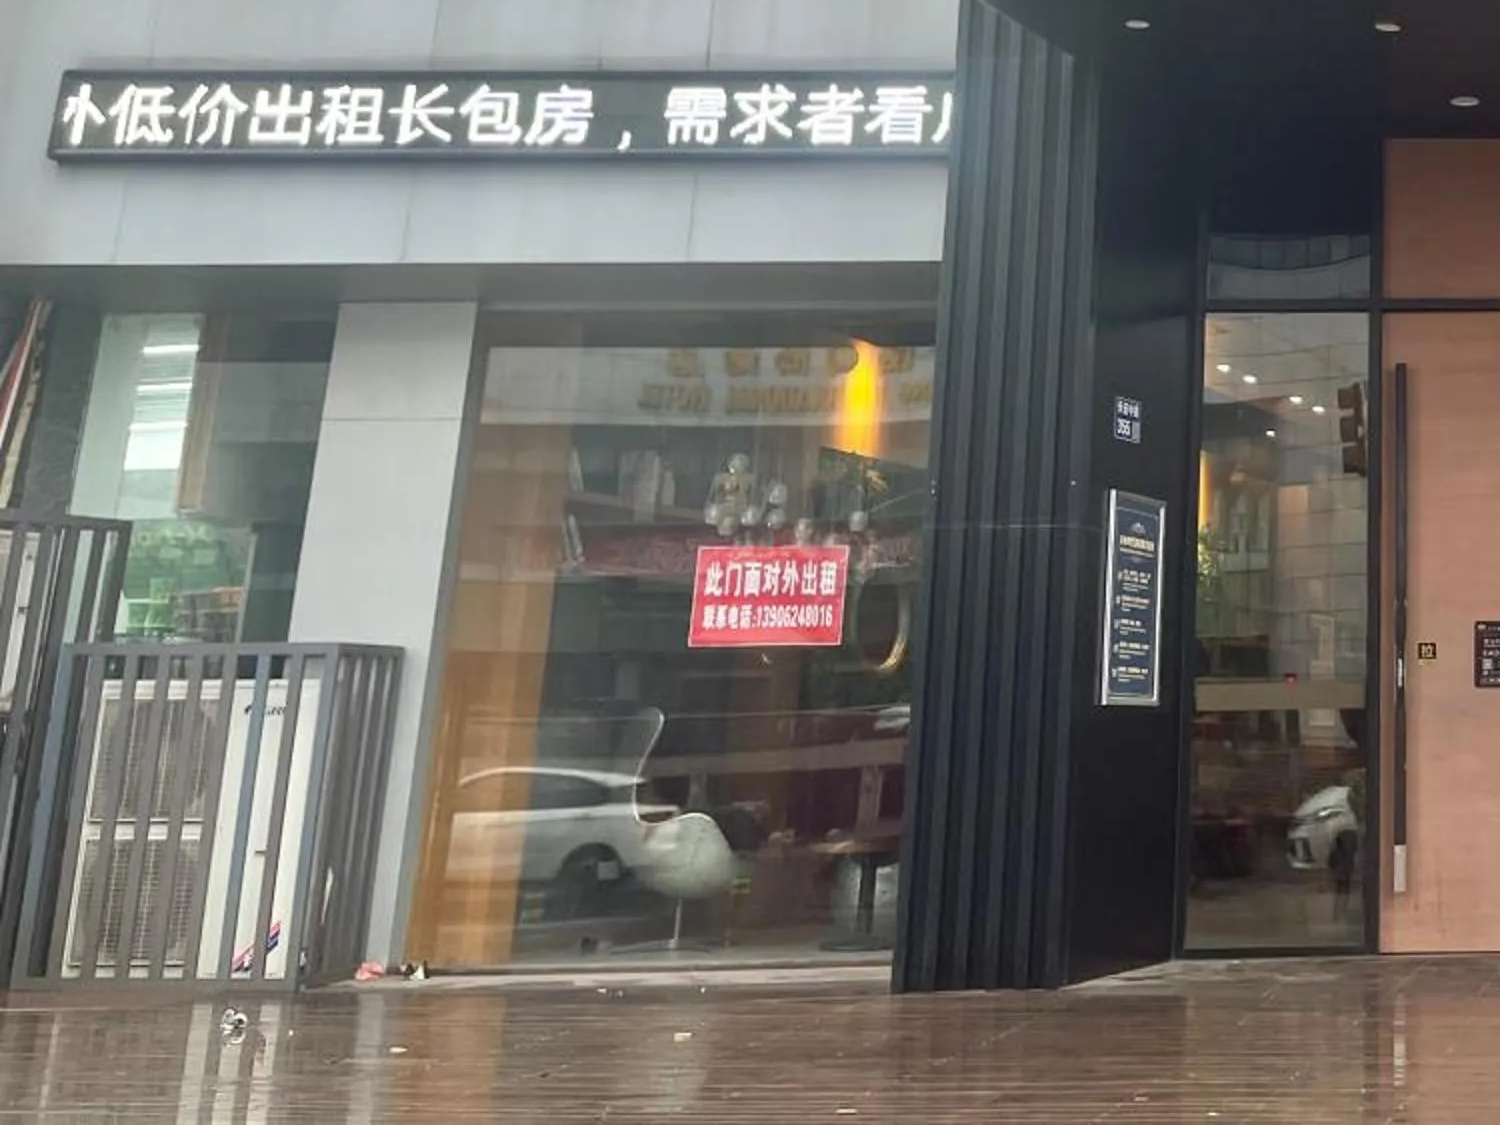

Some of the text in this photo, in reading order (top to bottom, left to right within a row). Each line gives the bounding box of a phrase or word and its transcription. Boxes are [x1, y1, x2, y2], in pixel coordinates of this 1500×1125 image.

[704, 561, 837, 596] 此门面对外出租
